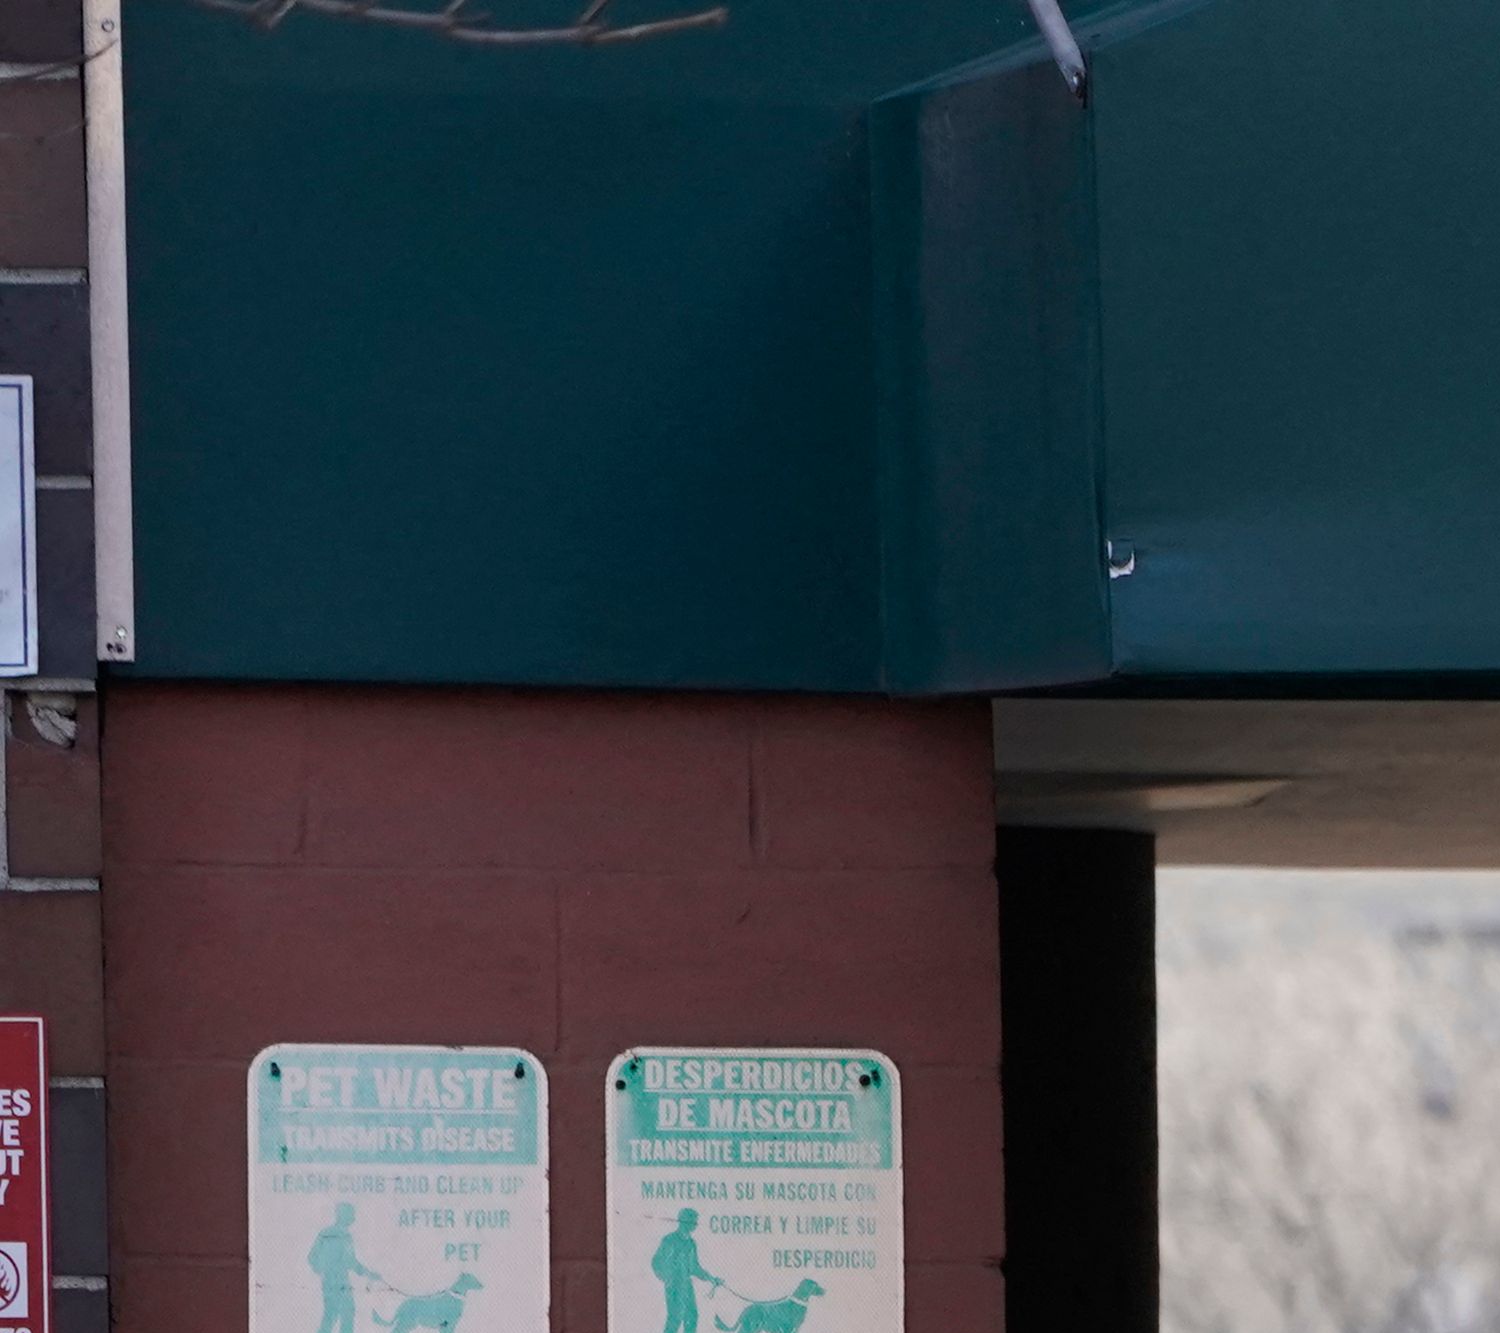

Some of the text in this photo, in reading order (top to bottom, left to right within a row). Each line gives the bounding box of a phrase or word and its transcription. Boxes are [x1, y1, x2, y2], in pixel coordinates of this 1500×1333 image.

[644, 1059, 863, 1091] DESPERDICIOS
[281, 1067, 518, 1110] PET WASTE
[658, 1097, 852, 1131] DE MASCOTA
[421, 1126, 515, 1152] DISEASE
[630, 1139, 734, 1163] TRANSMITE
[436, 1176, 493, 1194] CLEAN
[641, 1180, 728, 1200] MANTENGA
[735, 1182, 754, 1200] SU
[763, 1181, 837, 1201] MASCOTA
[399, 1209, 511, 1229] AFTER YOUR
[709, 1215, 876, 1236] CORREA Y LIMPIE SU
[444, 1244, 482, 1262] PET
